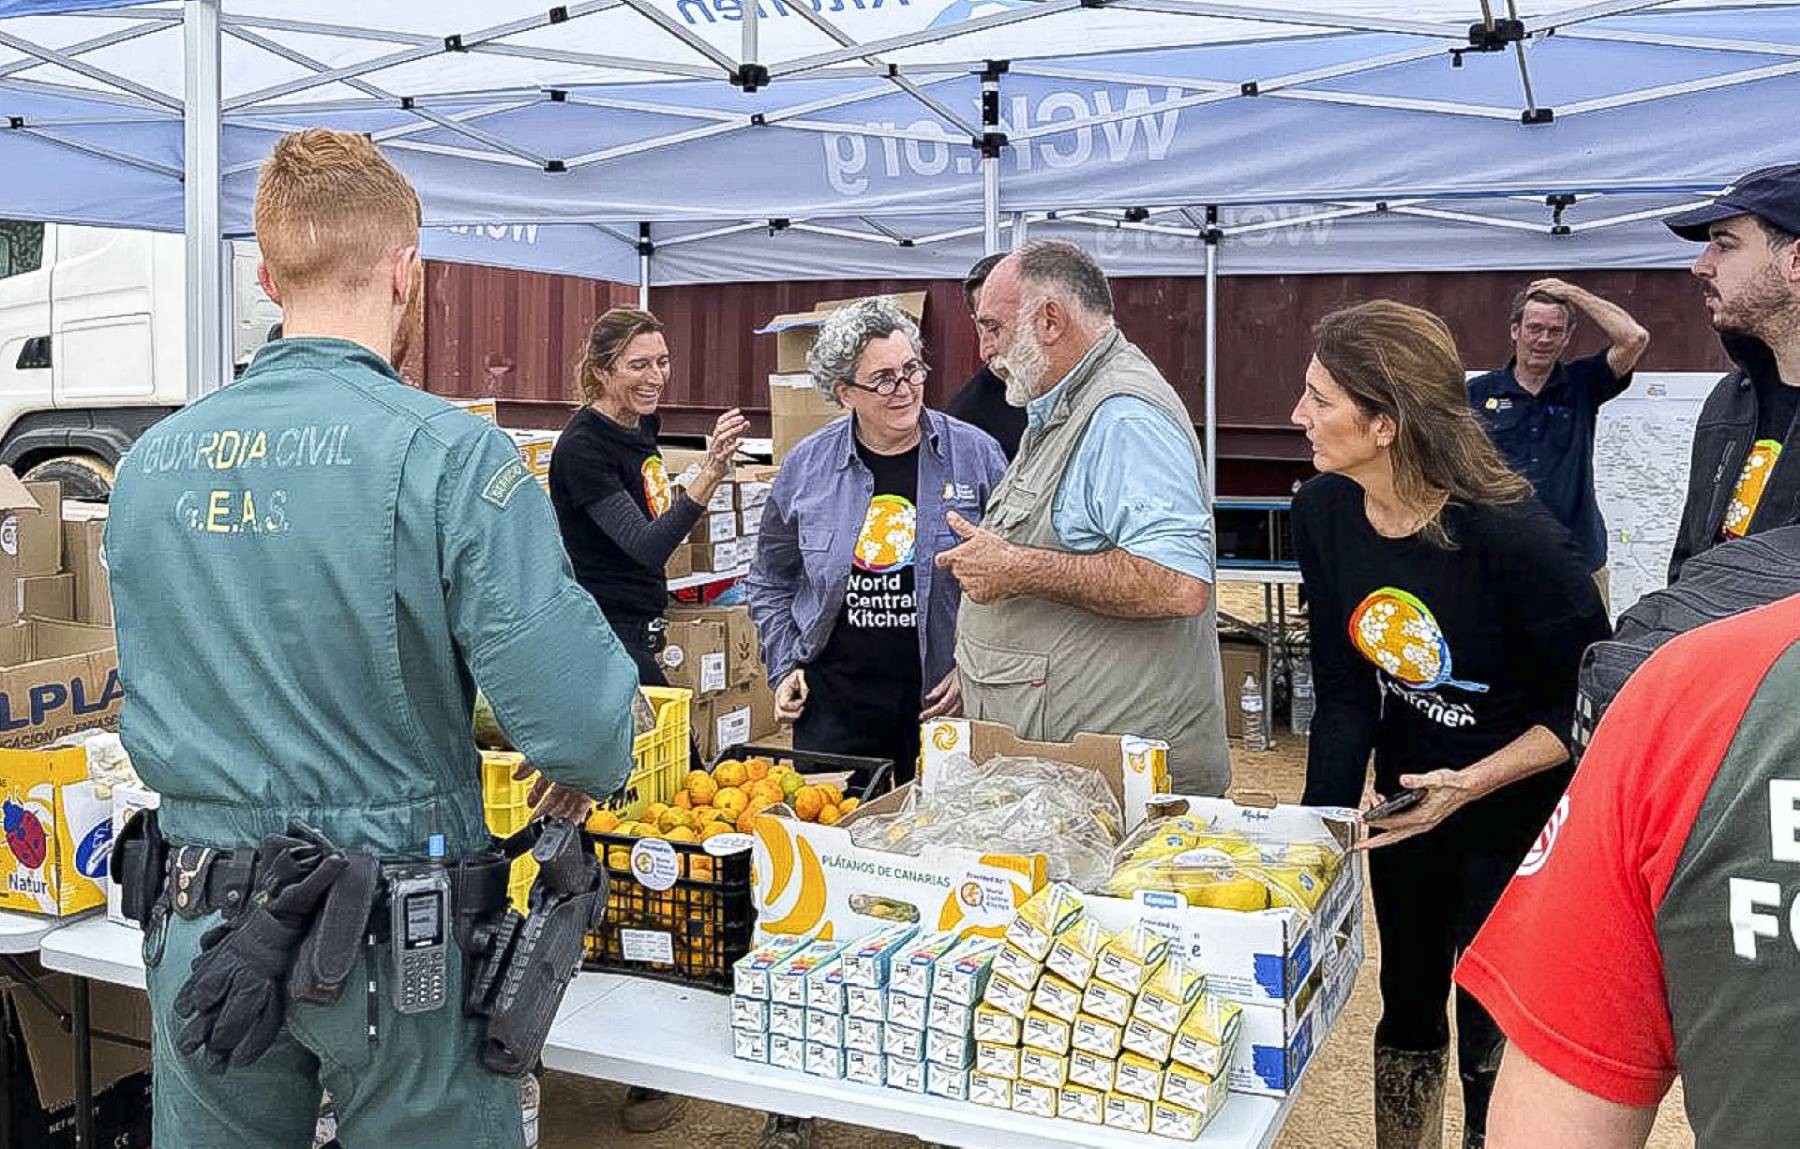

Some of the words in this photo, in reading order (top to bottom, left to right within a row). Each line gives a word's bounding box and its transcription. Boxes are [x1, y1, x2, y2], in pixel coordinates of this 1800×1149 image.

[143, 428, 267, 473] GUARDIA
[275, 423, 352, 467] CIVIL
[846, 590, 917, 608] Central
[8, 873, 48, 895] Natur
[821, 854, 875, 875] PLÁTANOS
[877, 865, 894, 877] DE
[894, 867, 951, 888] CANARIAS
[1728, 876, 1800, 961] F
